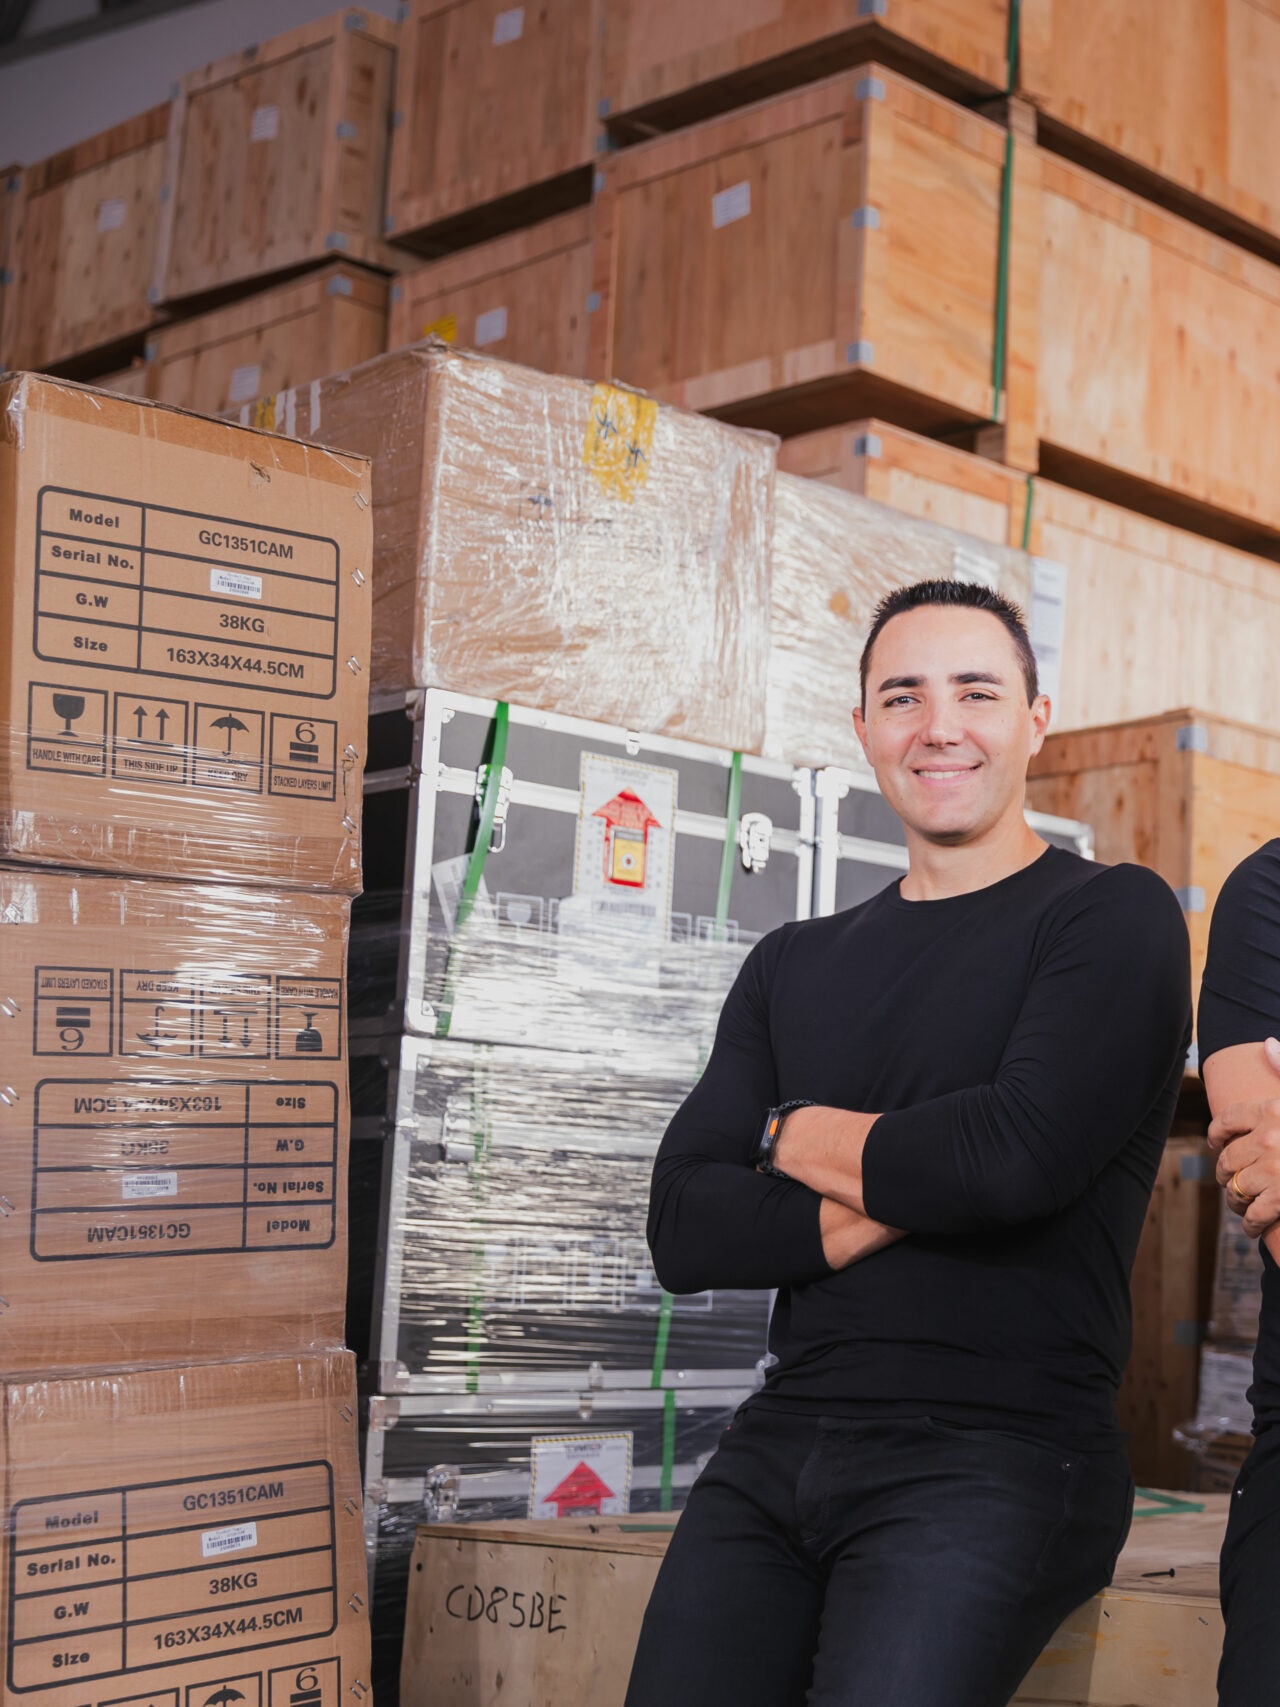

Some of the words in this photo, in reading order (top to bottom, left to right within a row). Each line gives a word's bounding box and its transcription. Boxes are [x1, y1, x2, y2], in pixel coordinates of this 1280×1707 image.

[69, 508, 120, 528] Model
[199, 529, 294, 560] GC1351CAM
[51, 545, 101, 565] Serial
[107, 554, 135, 570] No.
[75, 592, 109, 608] G.W
[219, 613, 265, 633] 38KG
[73, 636, 108, 652] Size
[166, 647, 305, 679] 163X34X44.5CM
[294, 721, 317, 744] 6
[33, 748, 62, 762] HANDLE
[63, 751, 81, 763] WITH
[82, 754, 102, 765] CARE
[123, 758, 143, 770] THIS
[273, 775, 298, 788] STACKED
[298, 778, 317, 790] LAYERS
[318, 780, 332, 791] LIMIT
[40, 977, 57, 988] LIMIT
[58, 978, 80, 989] LAYERS
[81, 979, 108, 990] STACKED
[136, 980, 154, 991] DRY
[275, 1097, 306, 1109] Size
[276, 1139, 305, 1152] G.W
[253, 1182, 277, 1194] No.
[282, 1181, 324, 1194] Serial
[88, 1223, 191, 1243] GC1351CAM
[267, 1219, 310, 1233] Model
[183, 1482, 284, 1511] GC1351CAM
[45, 1510, 99, 1530] Model
[26, 1556, 81, 1577] Serial
[87, 1552, 117, 1568] No.
[208, 1572, 258, 1594] 38KG
[53, 1601, 90, 1620] G.W
[446, 1584, 568, 1634] CD85BE
[154, 1608, 303, 1650] 163X34X44.5CM
[51, 1651, 91, 1668] Size
[295, 1666, 319, 1691] 6
